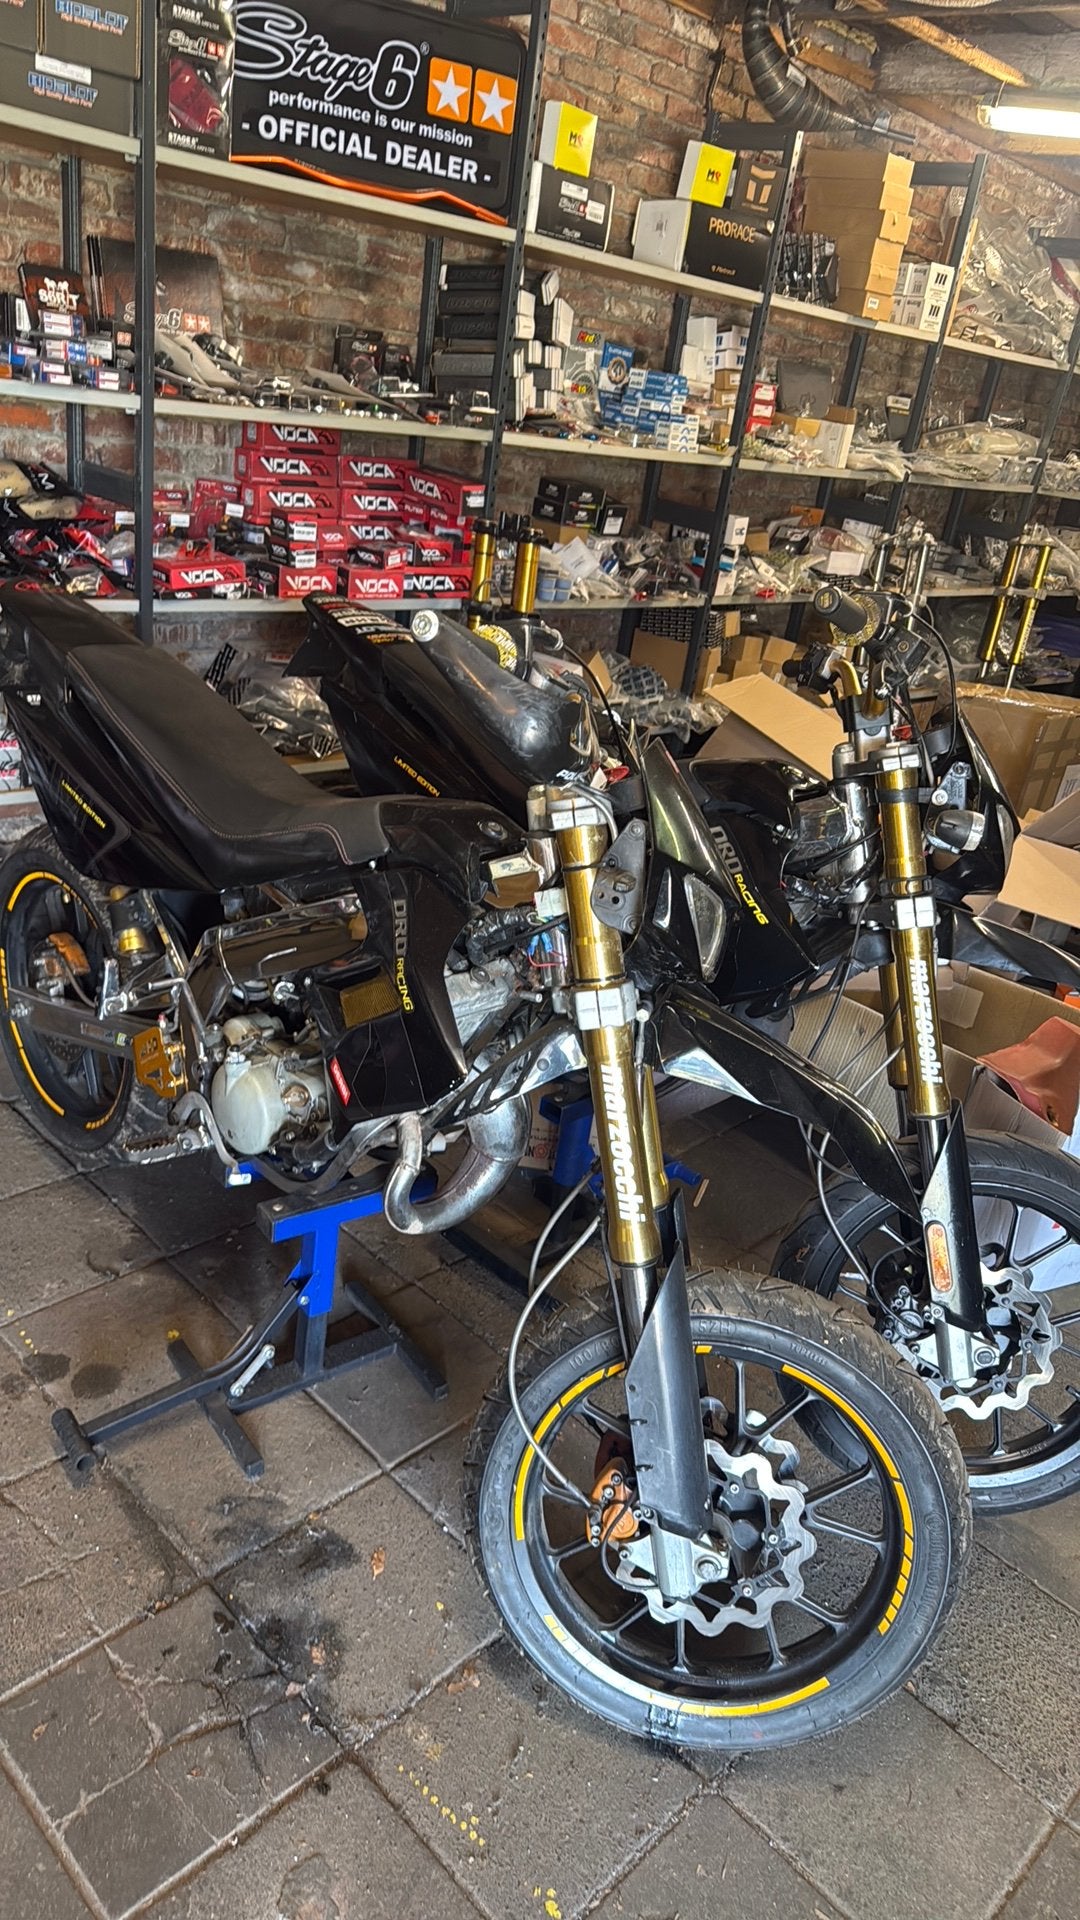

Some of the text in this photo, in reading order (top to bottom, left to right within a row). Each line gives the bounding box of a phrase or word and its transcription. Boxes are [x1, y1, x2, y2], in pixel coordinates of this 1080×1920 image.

[268, 88, 473, 148] performance is our mission
[258, 114, 378, 161] OFFICIAL
[385, 140, 478, 184] DEALER
[709, 216, 756, 244] PRORACE
[272, 425, 319, 444] VOCA
[260, 456, 312, 475] VOCA
[349, 461, 396, 479] VOCA
[409, 475, 442, 500] VOCA
[268, 491, 316, 508] VOCA
[353, 494, 399, 512] VOCA
[350, 524, 396, 540] VOCA
[179, 568, 225, 585] VOCA
[286, 575, 333, 590] VOCA
[354, 578, 399, 593] VOCA
[411, 575, 456, 590] VOCA
[394, 755, 440, 798] LIMITED EDITION
[61, 779, 107, 829] LIMITED EDITION
[709, 825, 770, 926] DRD RACING
[393, 899, 414, 1012] DRD RACING
[908, 958, 943, 1084] marzocchi
[601, 1063, 647, 1224] marzocchi
